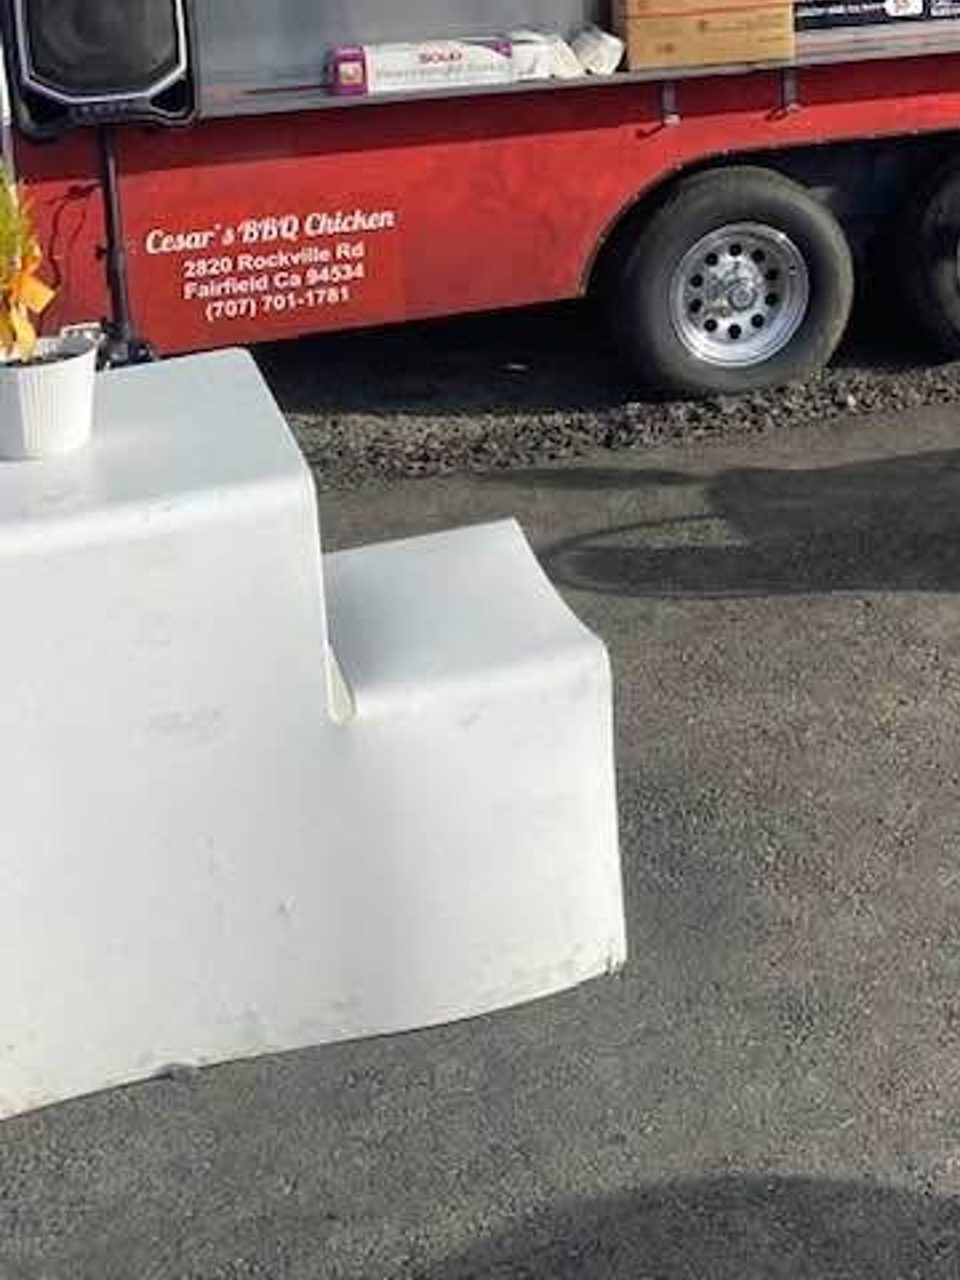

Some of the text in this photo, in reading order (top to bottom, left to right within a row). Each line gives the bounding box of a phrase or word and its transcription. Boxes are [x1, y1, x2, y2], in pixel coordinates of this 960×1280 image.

[146, 209, 395, 254] Cesar's BBQ Chicken
[183, 242, 365, 279] 2820 Rockville Rd
[183, 262, 365, 300] Fairfield Ca 94534
[205, 286, 349, 322] (707) 701-1781
